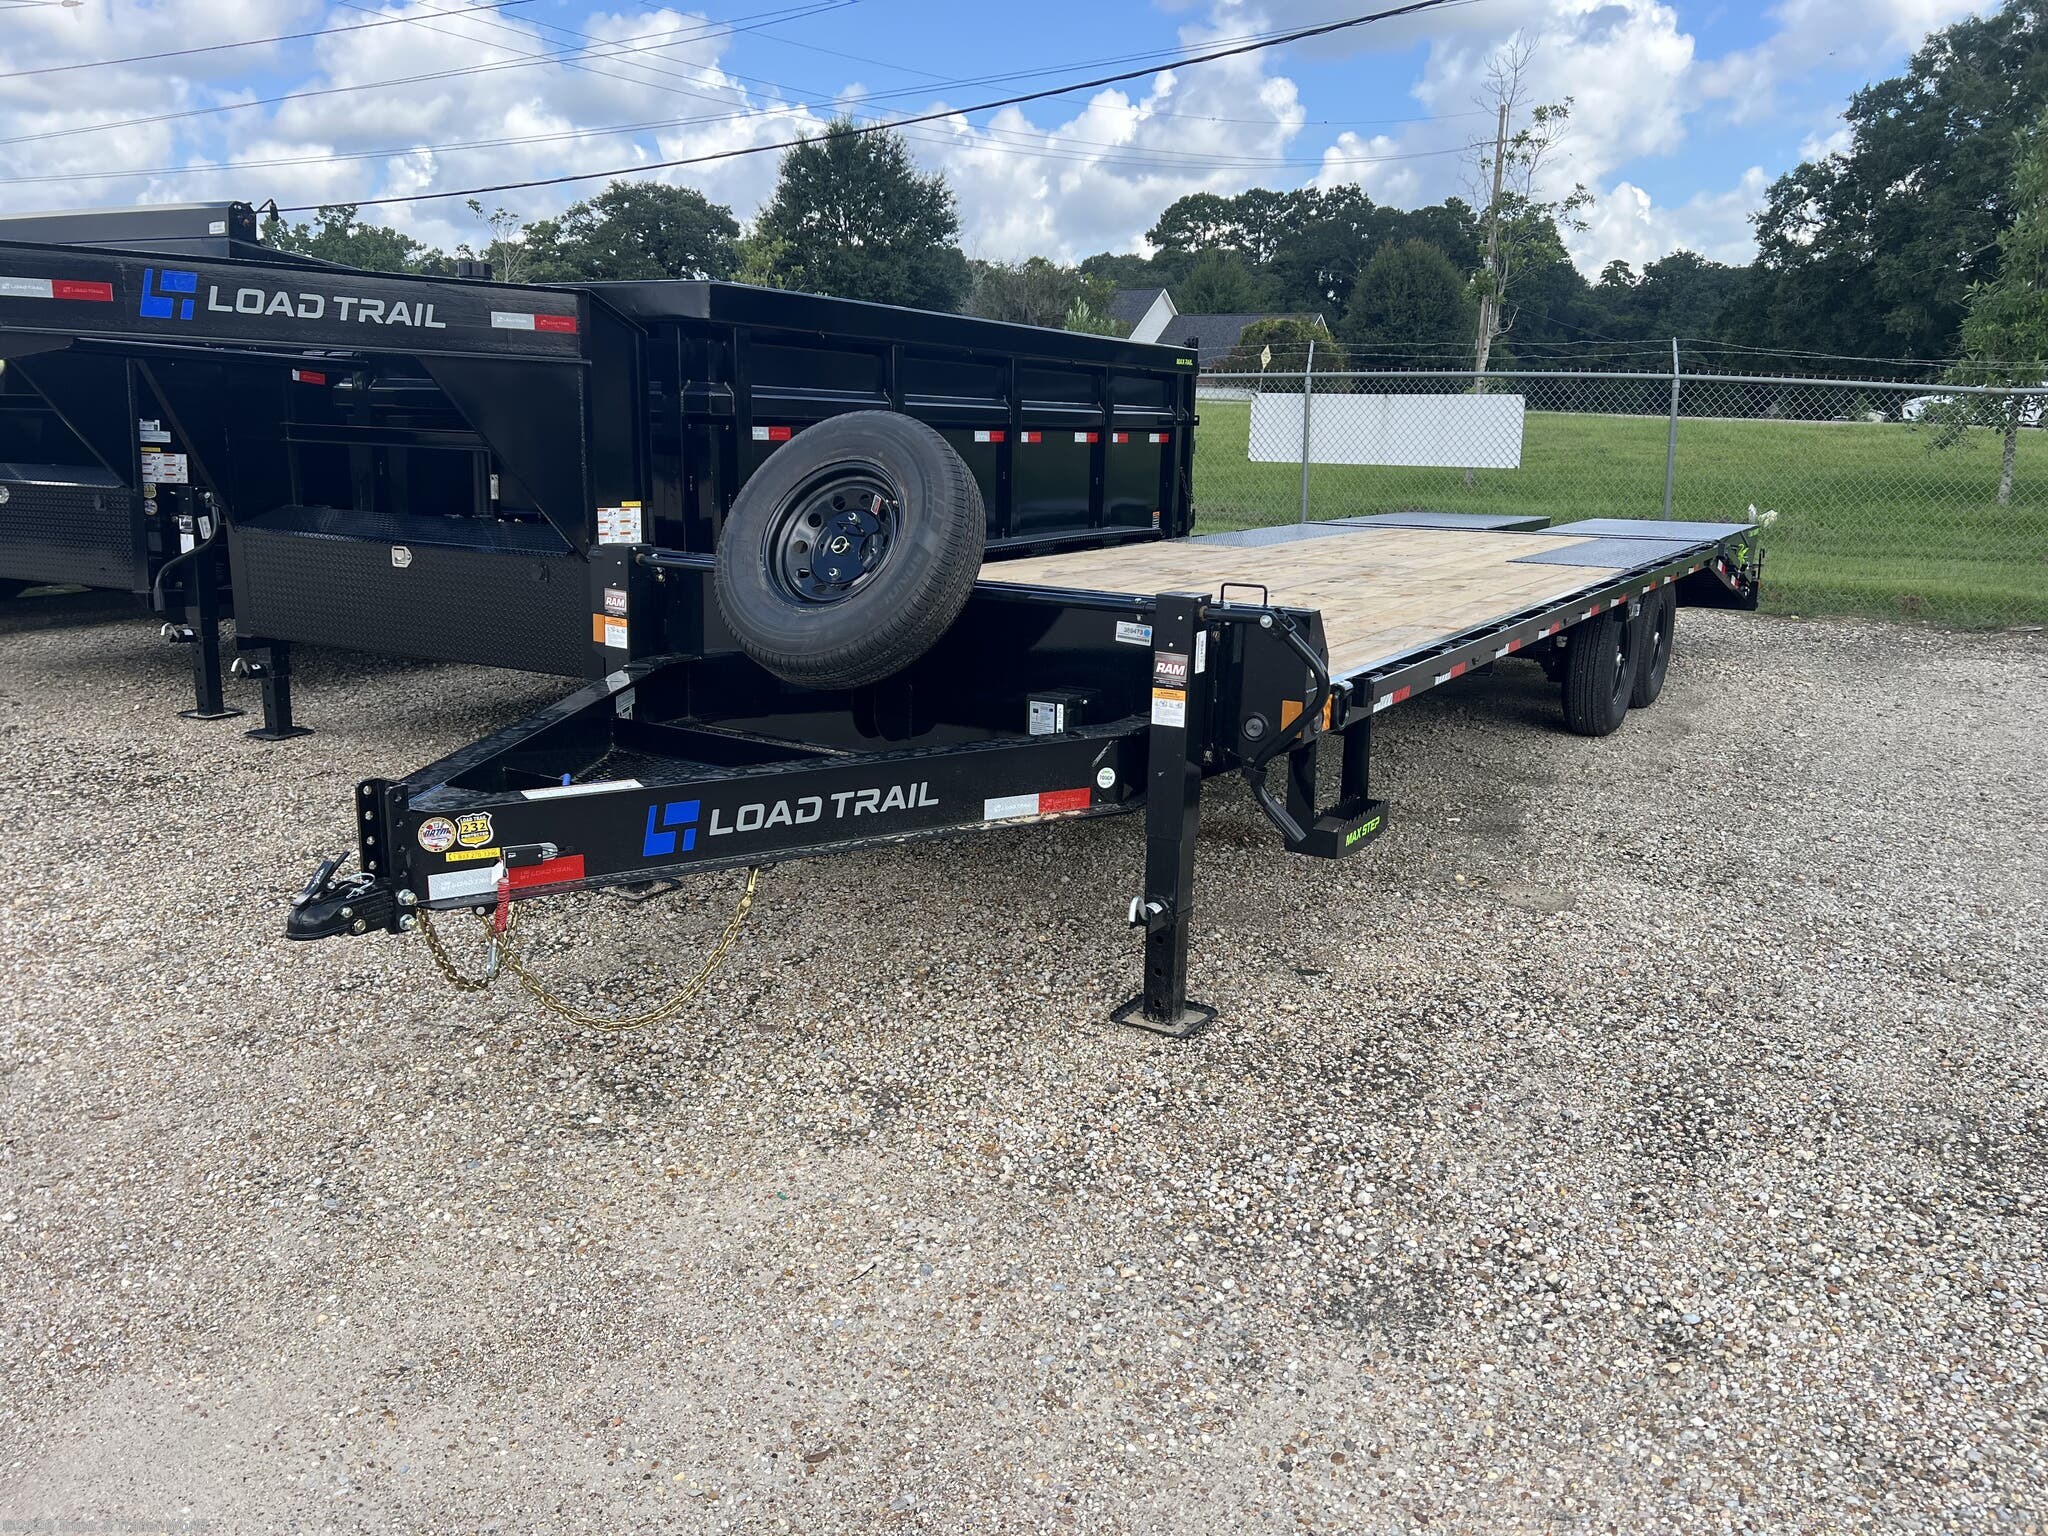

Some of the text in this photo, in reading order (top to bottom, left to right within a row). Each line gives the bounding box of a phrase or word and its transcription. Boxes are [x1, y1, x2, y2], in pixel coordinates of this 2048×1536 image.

[207, 285, 447, 329] LOAD TRAIL
[605, 596, 625, 608] RAM
[1156, 662, 1185, 676] RAM
[708, 781, 939, 836] LOAD TRAIL
[463, 822, 486, 833] 232
[1346, 816, 1380, 847] MAX STEP
[530, 865, 574, 878] LOAD TRAIL
